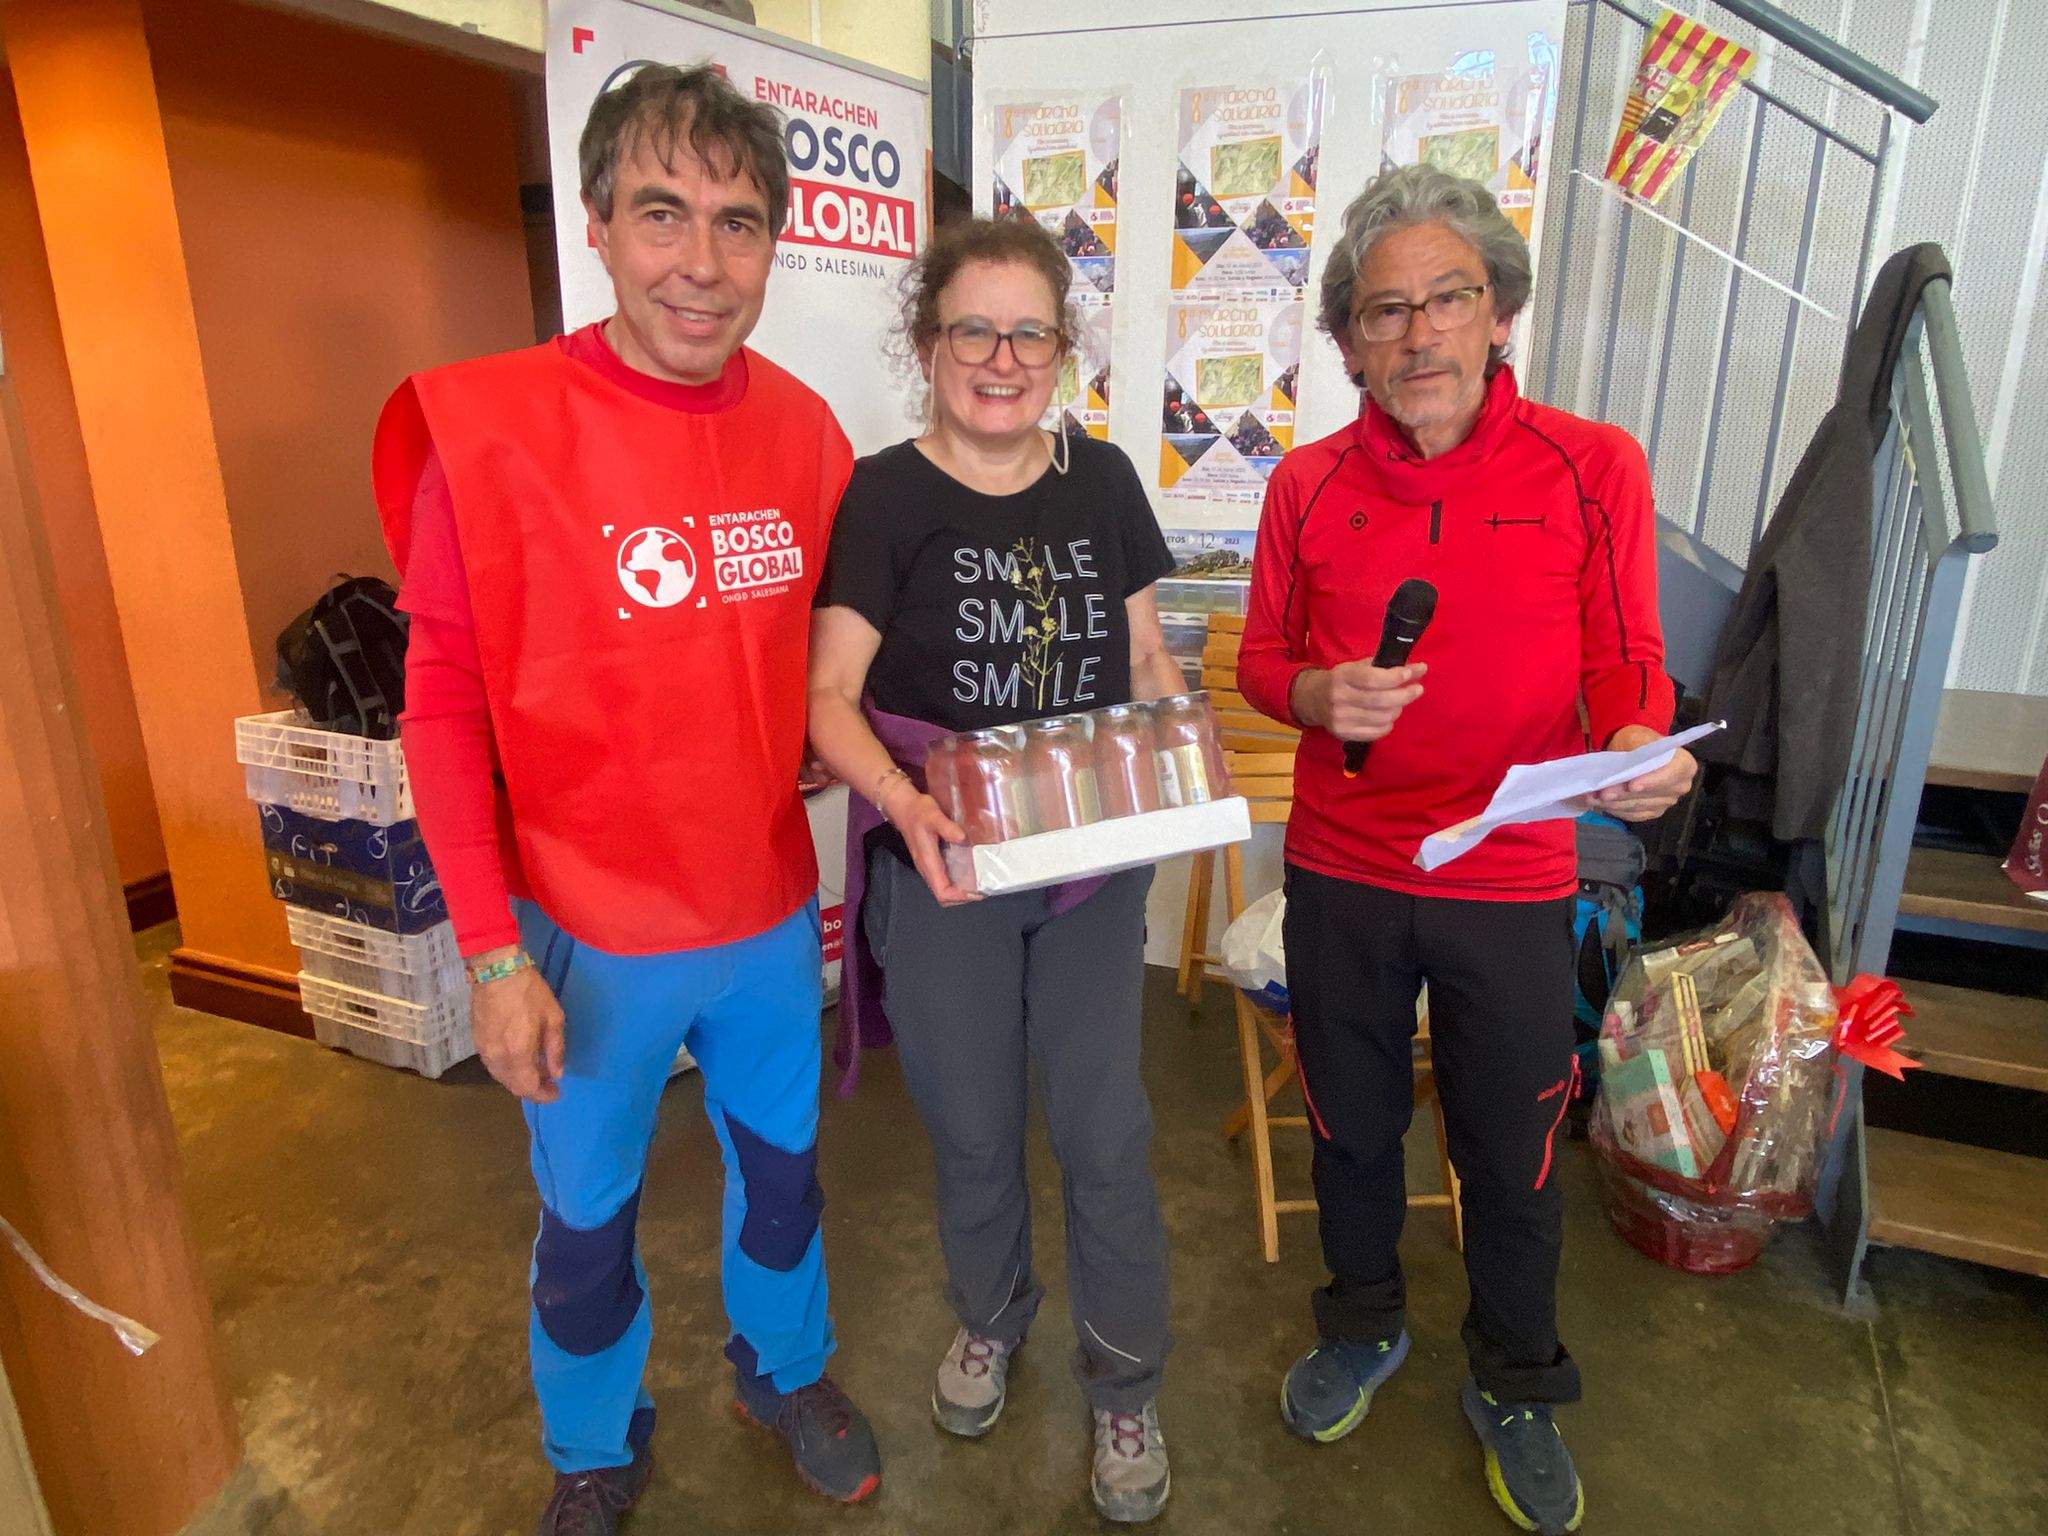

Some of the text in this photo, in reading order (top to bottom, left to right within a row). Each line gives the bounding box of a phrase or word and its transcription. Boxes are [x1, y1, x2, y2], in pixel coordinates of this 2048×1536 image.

[754, 76, 879, 130] ENTARACHEN
[784, 118, 901, 189] OSCO
[774, 252, 886, 280] NGD SALESIANA
[708, 508, 781, 527] ENTARACHEN
[711, 520, 795, 556] BOSCO
[1166, 535, 1187, 544] ETOS
[718, 551, 801, 586] GLOBAL
[751, 585, 790, 600] SALESIANA
[823, 919, 842, 934] bo
